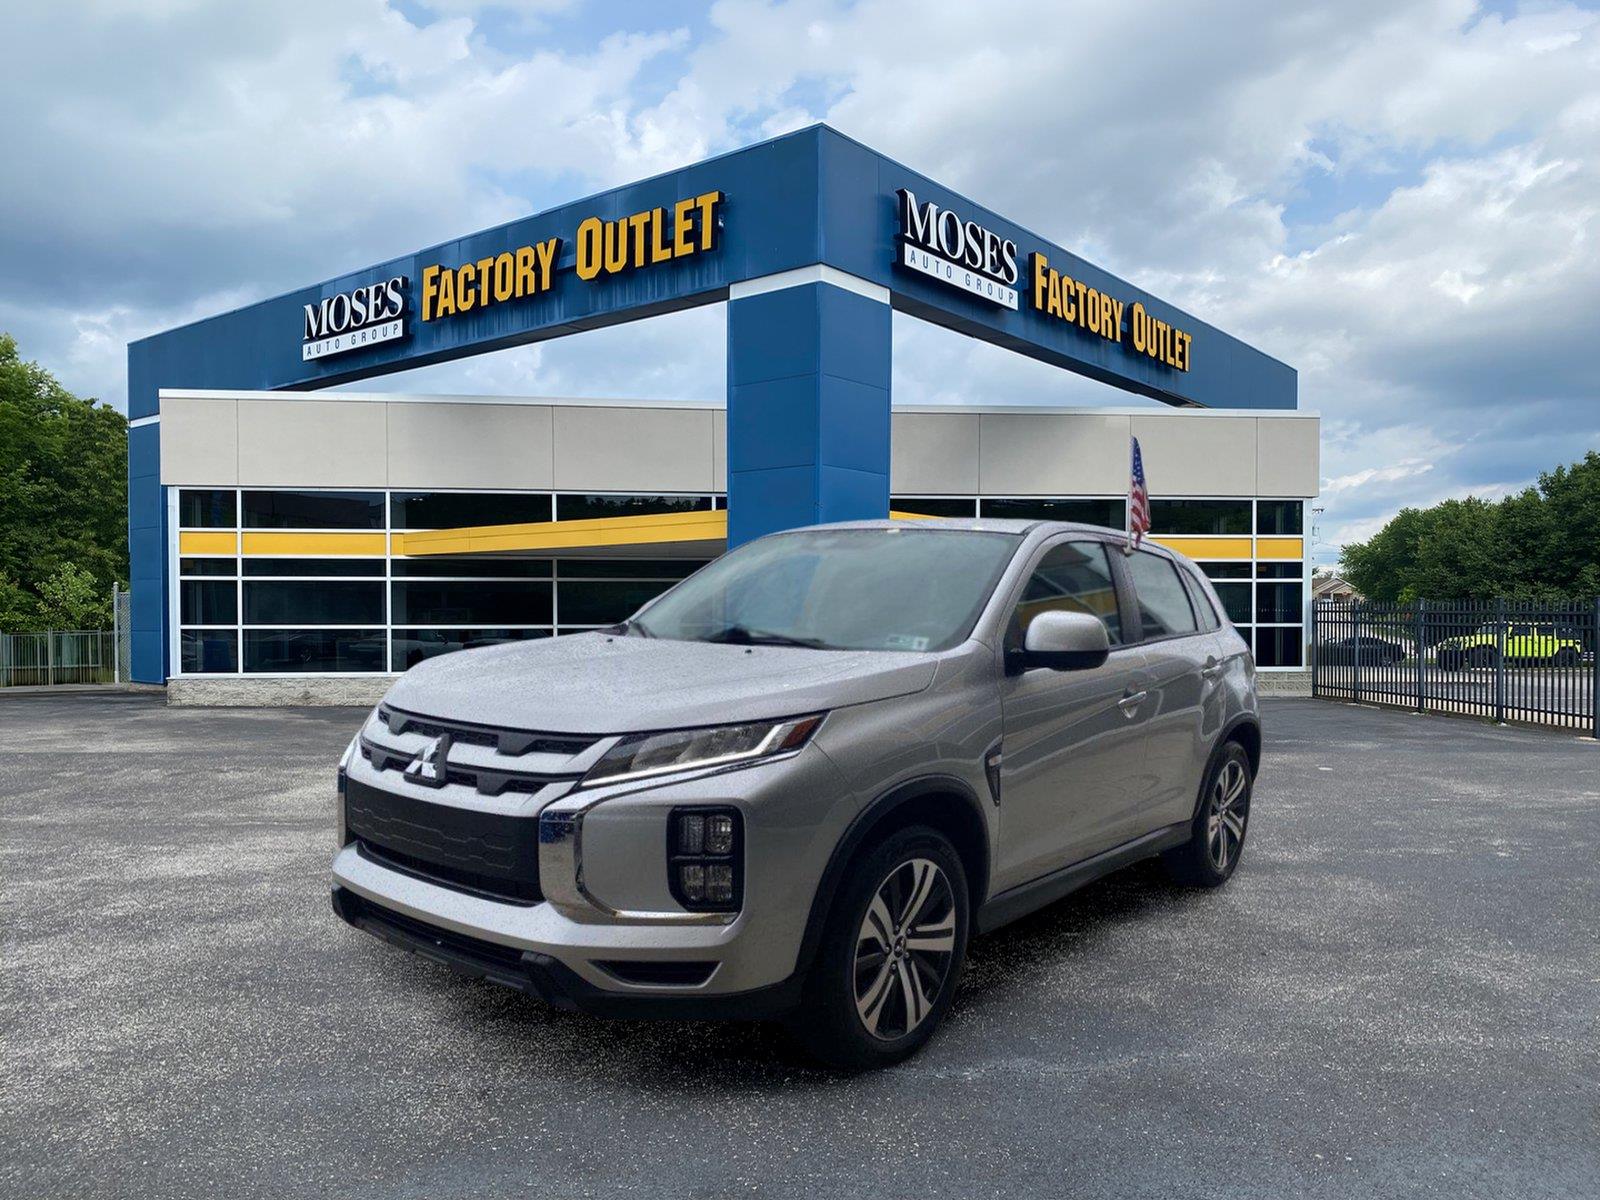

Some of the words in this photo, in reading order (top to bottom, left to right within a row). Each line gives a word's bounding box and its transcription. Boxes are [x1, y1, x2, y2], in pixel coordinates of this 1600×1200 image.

[903, 188, 1018, 285] MOSES
[909, 250, 953, 279] AUTO
[965, 267, 1014, 304] GROUP
[303, 276, 404, 340] MOSES
[306, 337, 340, 357] AUTO
[350, 324, 399, 345] GROUP
